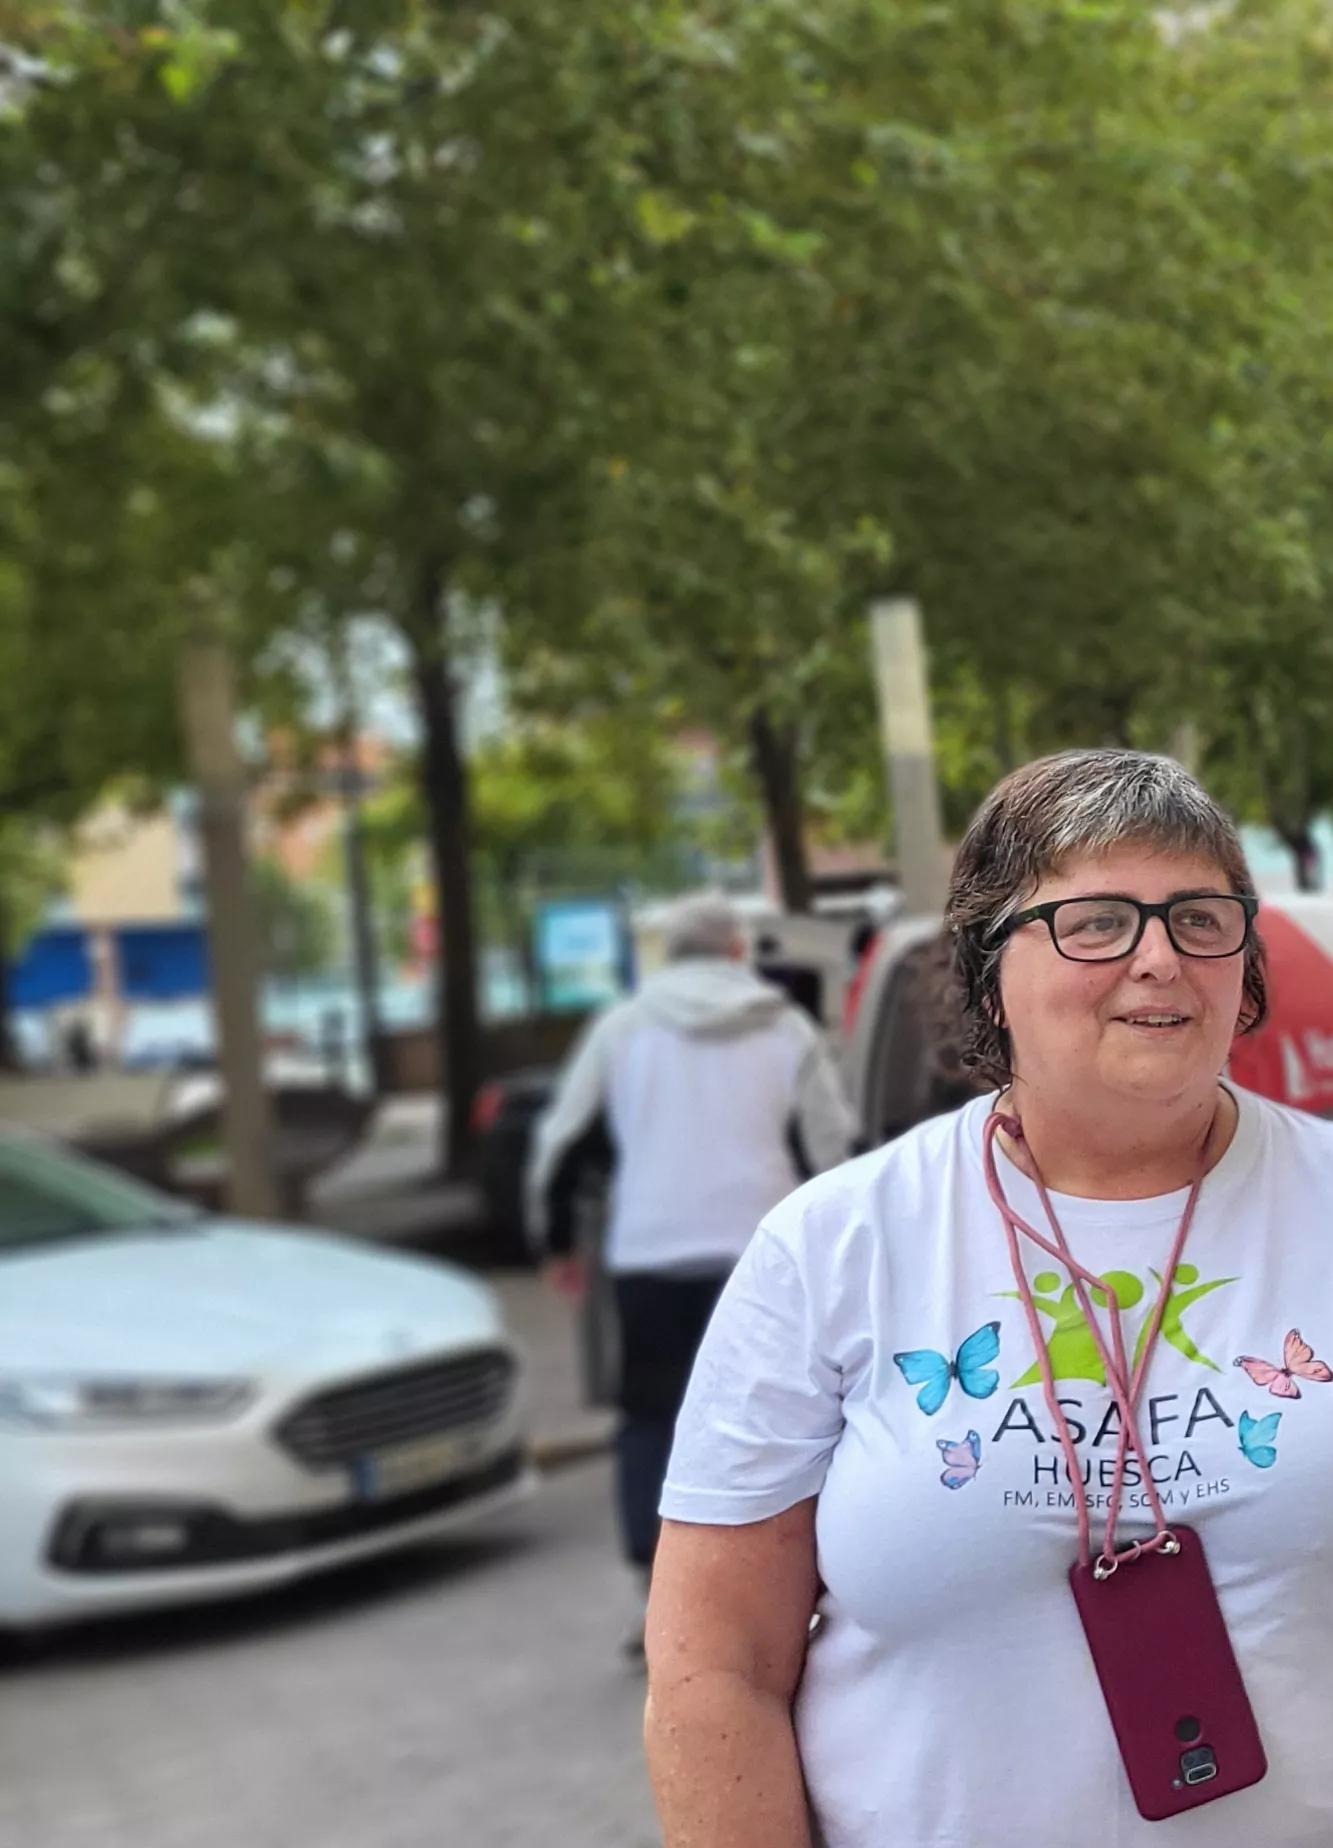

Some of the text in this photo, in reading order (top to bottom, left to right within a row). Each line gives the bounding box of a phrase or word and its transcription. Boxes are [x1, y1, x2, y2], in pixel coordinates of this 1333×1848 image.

[992, 1387, 1235, 1452] ASAFA
[1034, 1451, 1201, 1487] HUESCA
[1003, 1491, 1039, 1508] FM,
[1047, 1492, 1122, 1510] EMSFC,
[1197, 1479, 1230, 1498] EHS
